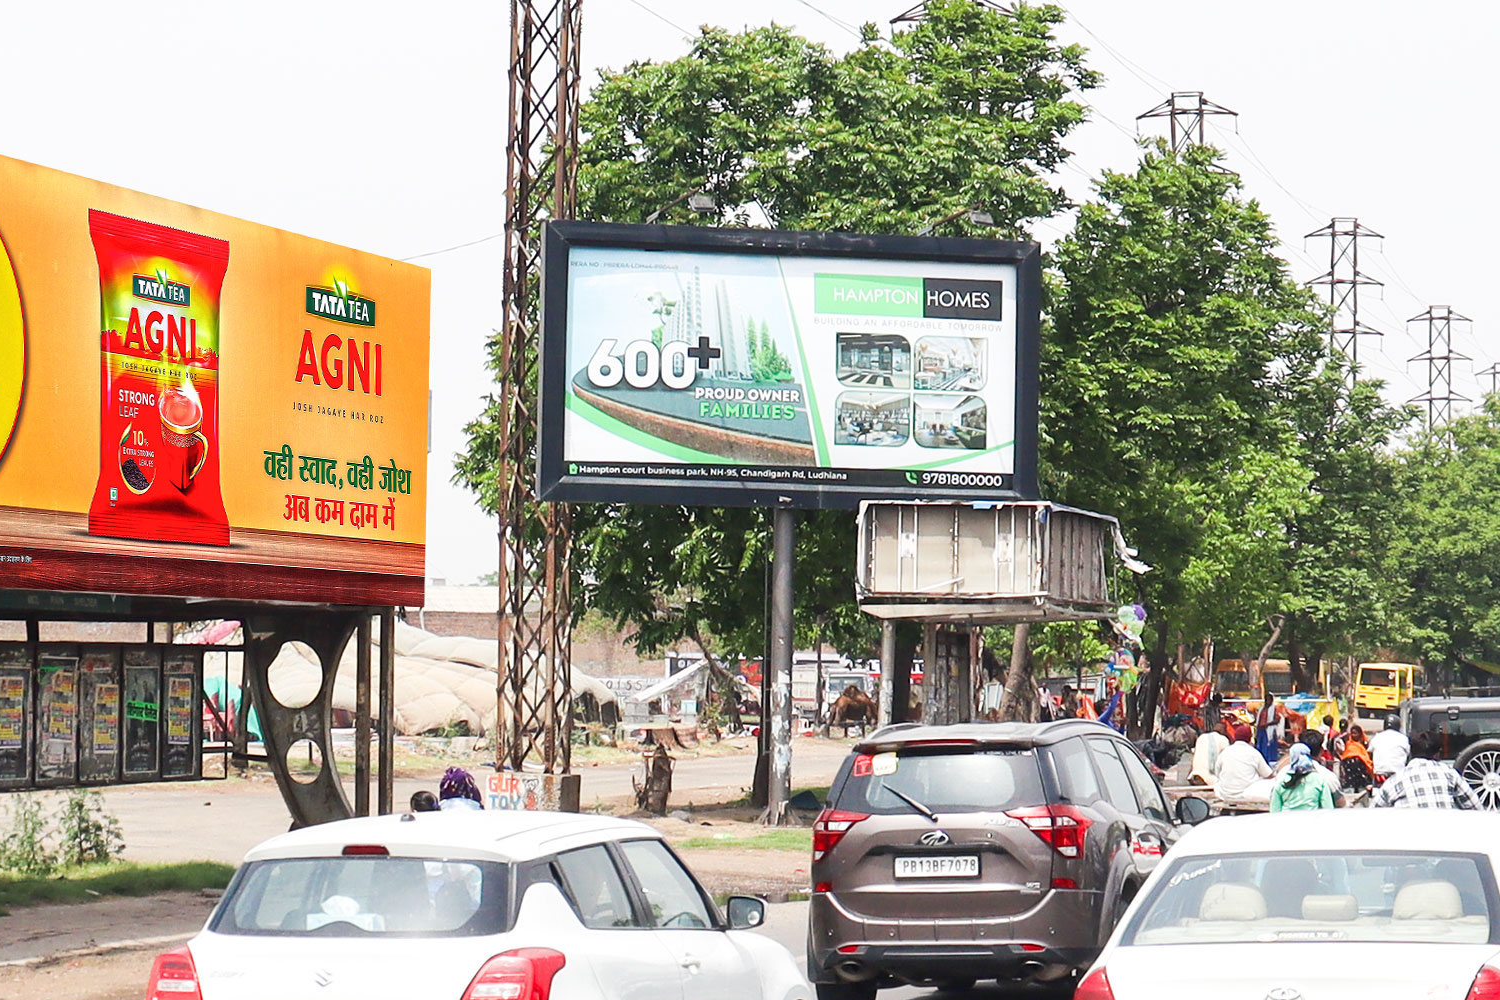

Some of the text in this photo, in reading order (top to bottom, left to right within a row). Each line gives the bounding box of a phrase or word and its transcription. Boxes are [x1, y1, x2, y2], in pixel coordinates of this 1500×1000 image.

[138, 279, 185, 302] TATA TEA
[834, 287, 990, 309] HAMPTON HOMES
[312, 292, 369, 322] TATA TEA
[124, 307, 196, 359] AGNI
[813, 317, 1002, 332] BUILDING AN AFFORDABLE TOMORROW
[295, 329, 382, 397] AGNI
[587, 336, 721, 390] 600+
[118, 388, 155, 407] STRONG
[695, 387, 800, 402] PROUD OWNER
[119, 405, 139, 418] LEAF
[700, 402, 796, 420] FAMILIES
[264, 444, 293, 480] वही
[347, 455, 374, 490] वही
[379, 459, 412, 494] जोश
[579, 465, 621, 475] Hampton
[622, 466, 645, 475] court
[647, 467, 684, 476] business
[740, 469, 791, 479] Chandigarh
[808, 470, 847, 480] Ludhiana
[922, 473, 1002, 486] 9781800000
[283, 494, 395, 531] अब कम दाम में
[488, 775, 520, 793] GUR
[488, 794, 521, 810] TOY
